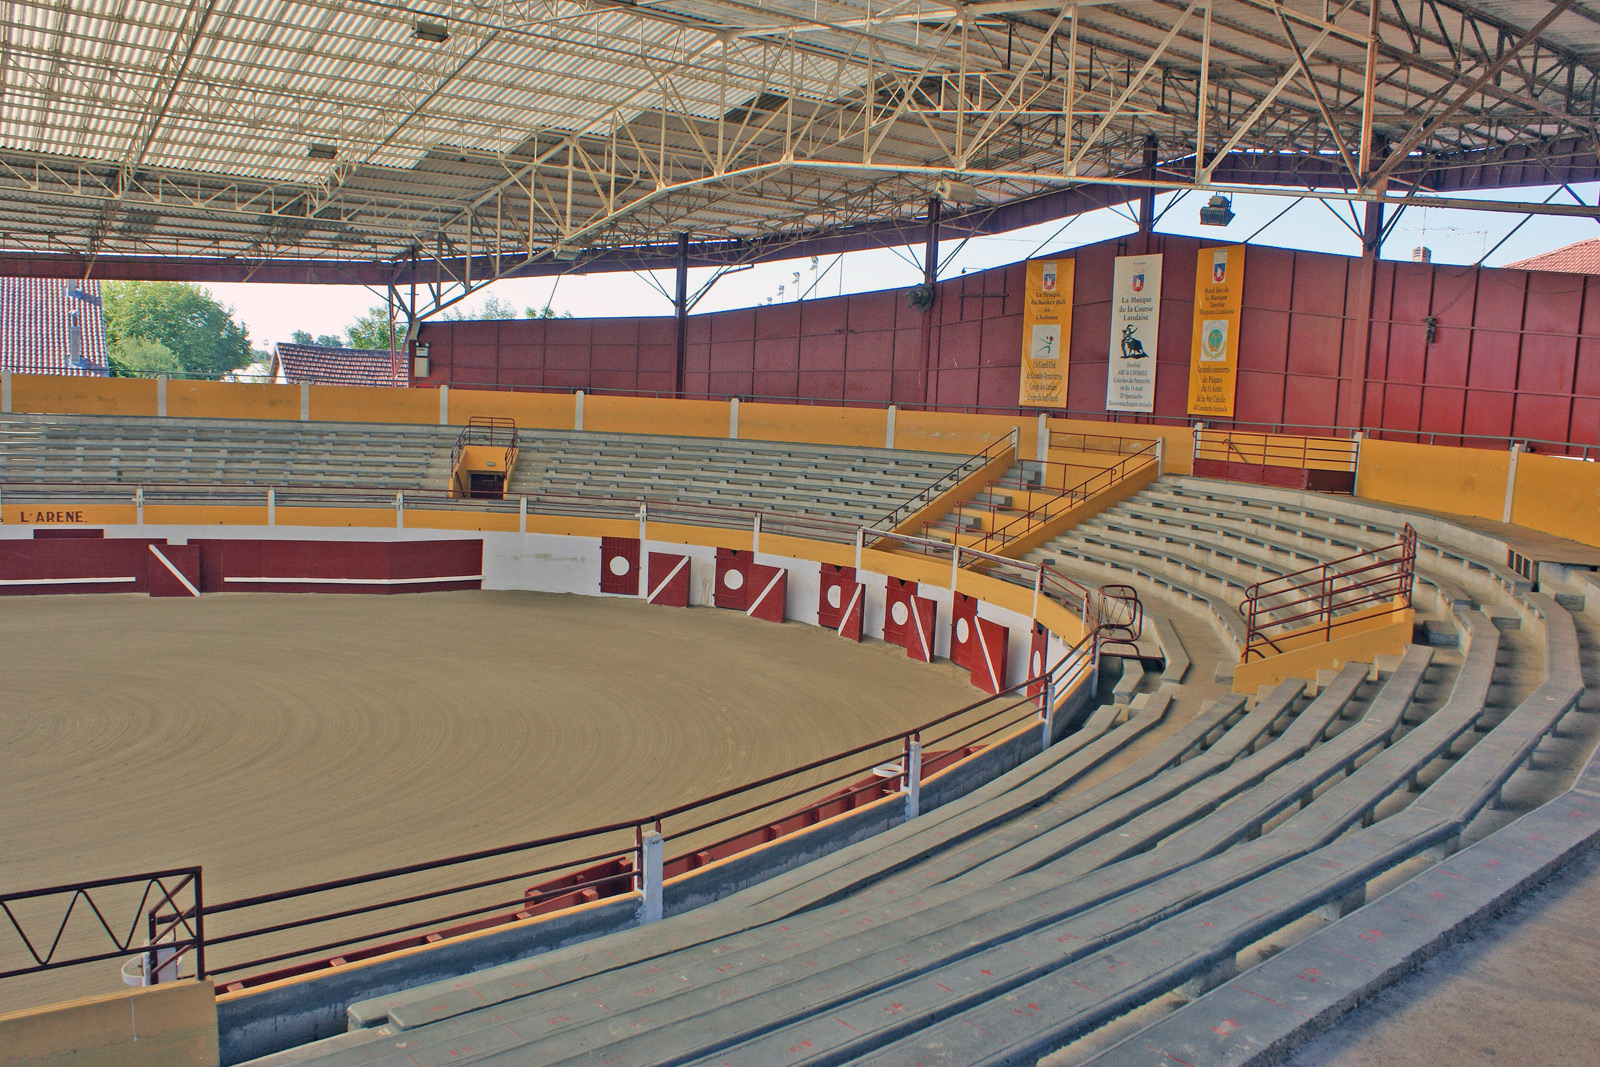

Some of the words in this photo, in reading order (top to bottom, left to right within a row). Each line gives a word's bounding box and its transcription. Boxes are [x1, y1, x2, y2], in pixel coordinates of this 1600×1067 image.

[1043, 291, 1061, 299] Temple
[1130, 296, 1152, 304] Mecque
[1197, 365, 1211, 373] Grands
[1209, 376, 1223, 385] Pâques
[1030, 383, 1039, 391] Coupe
[1201, 384, 1206, 392] du
[1213, 395, 1226, 403] Cécile
